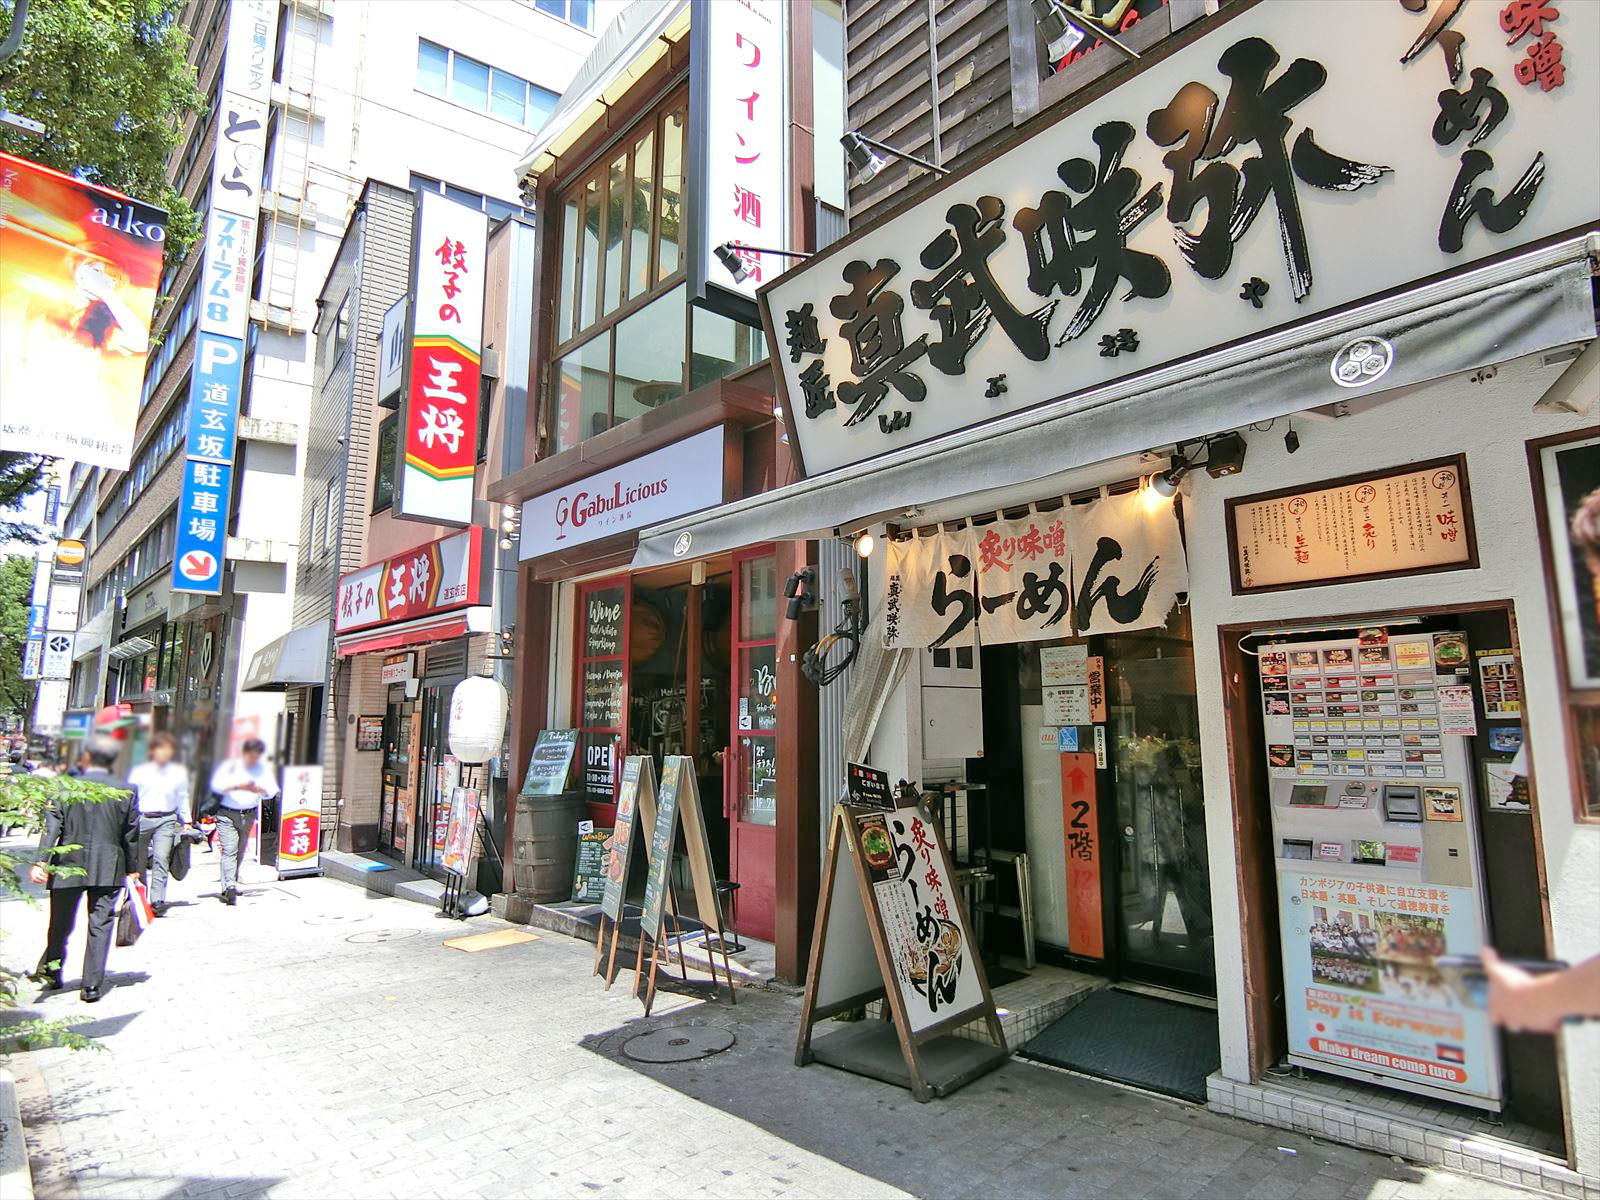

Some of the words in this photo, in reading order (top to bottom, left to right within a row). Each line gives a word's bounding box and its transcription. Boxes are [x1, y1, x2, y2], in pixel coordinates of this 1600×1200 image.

[3, 168, 19, 192] New
[91, 203, 166, 243] aiko
[207, 214, 238, 322] フォーラム8
[435, 236, 468, 324] 餃子の
[200, 339, 238, 375] P
[419, 356, 467, 453] 王将
[189, 383, 230, 542] 道玄坂駐車場
[571, 479, 668, 528] GabuLicious
[978, 520, 1066, 574] 炙り味噌
[1436, 510, 1458, 542] 味噌
[388, 553, 430, 610] 王将
[928, 536, 1160, 652] らーめん
[589, 600, 621, 623] Wine
[1088, 671, 1103, 709] 営業中
[588, 745, 613, 766] OPE
[756, 746, 765, 757] 2F
[1041, 734, 1056, 743] au
[290, 816, 311, 854] 王将
[1068, 800, 1093, 862] 2階
[911, 817, 949, 921] 炙り味噌
[890, 820, 957, 1013] らーめん
[1306, 998, 1340, 1019] Pay
[1318, 1039, 1349, 1057] Make
[1351, 1046, 1390, 1067] dream
[1392, 1056, 1427, 1075] come
[1429, 1063, 1456, 1081] ture
